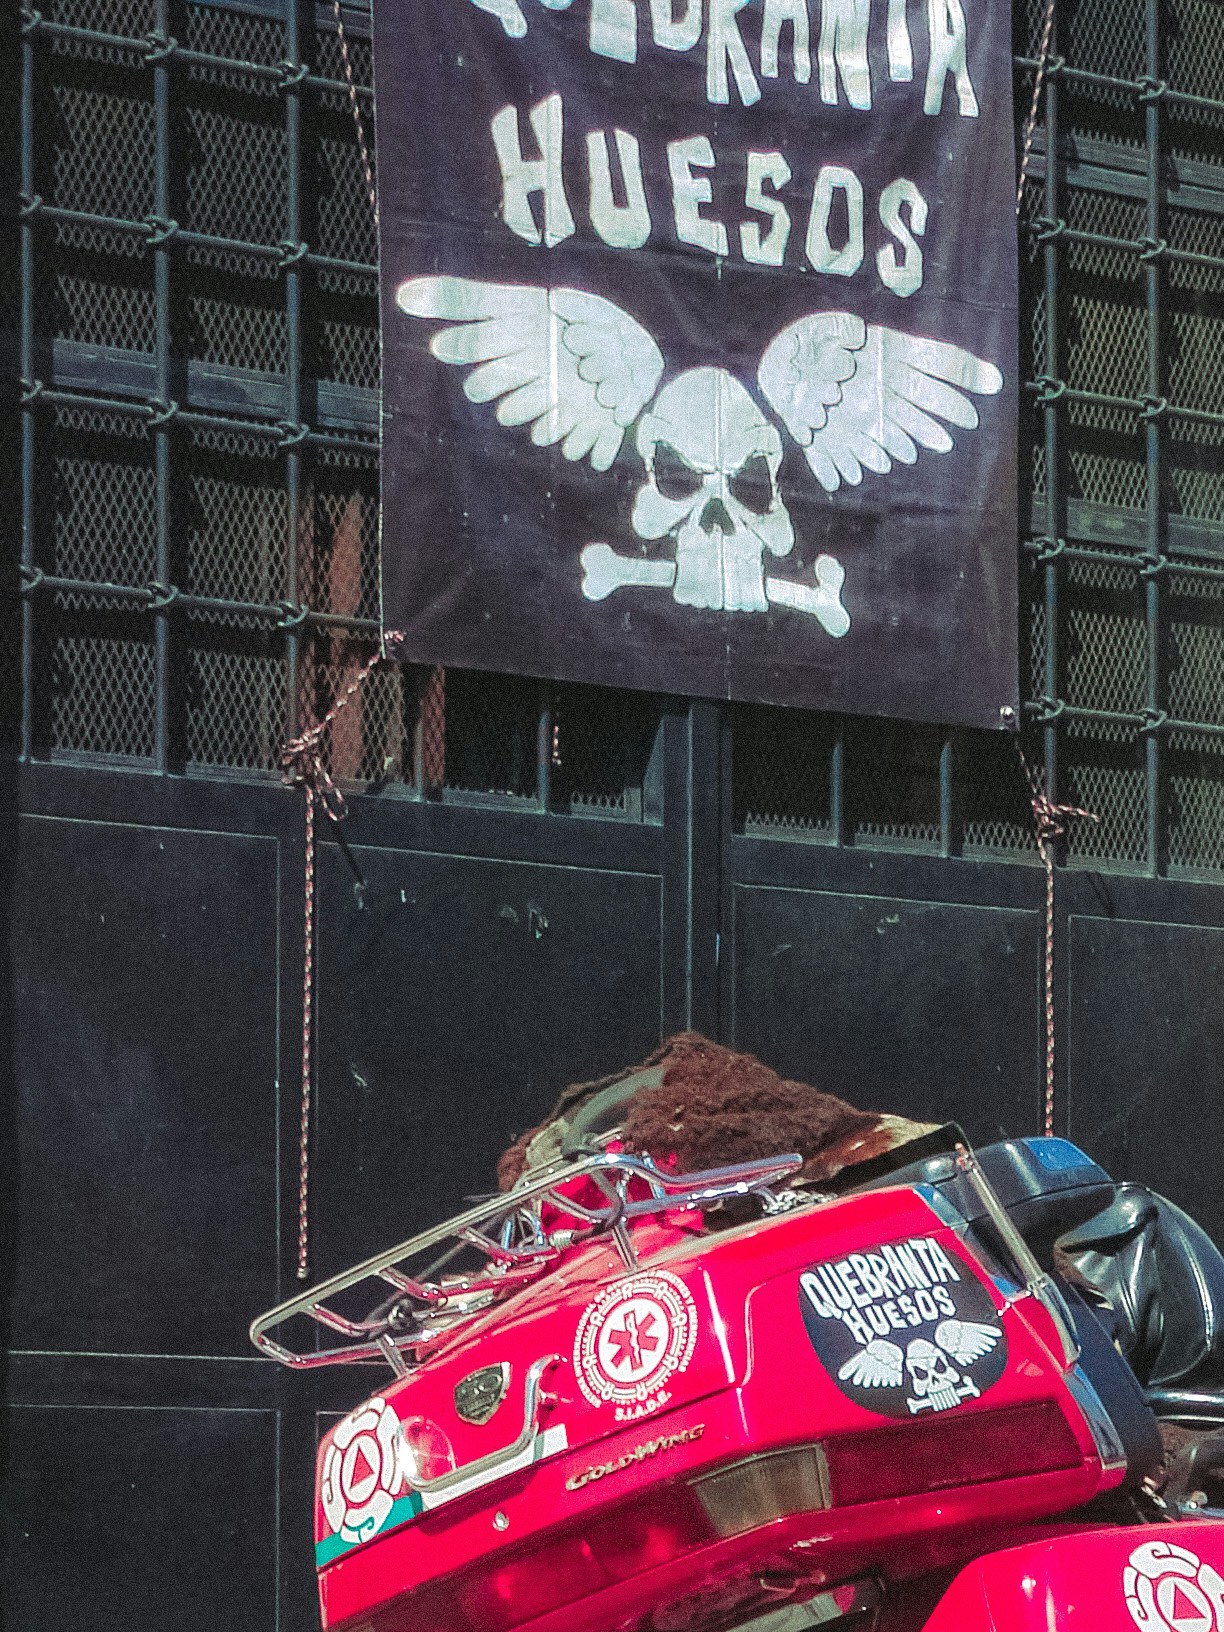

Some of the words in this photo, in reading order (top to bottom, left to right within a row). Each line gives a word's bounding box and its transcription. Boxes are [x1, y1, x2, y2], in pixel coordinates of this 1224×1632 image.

[492, 94, 928, 297] HUESOS
[799, 1237, 961, 1319] QUEBRANTA
[841, 1285, 957, 1345] HUESOS
